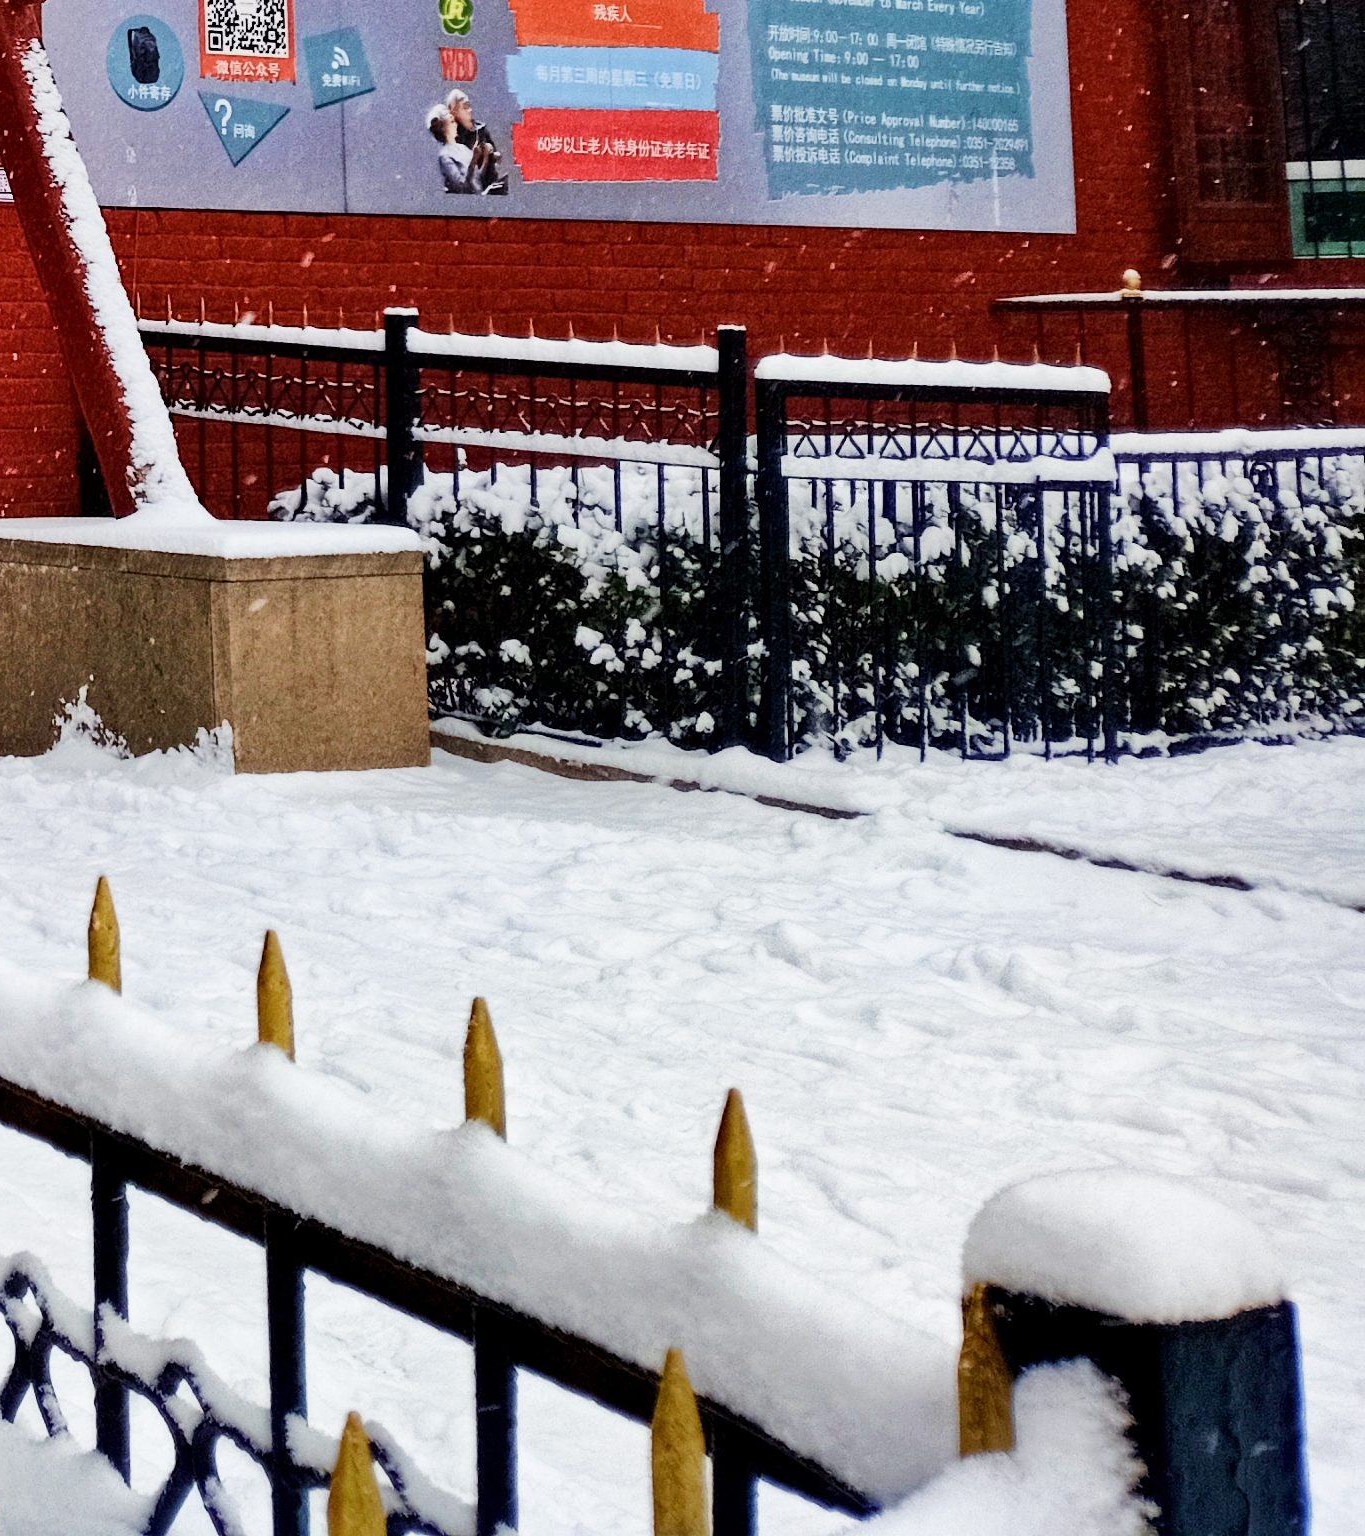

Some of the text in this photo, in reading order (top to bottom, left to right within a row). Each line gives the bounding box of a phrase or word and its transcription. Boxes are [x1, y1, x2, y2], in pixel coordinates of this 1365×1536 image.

[594, 3, 633, 23] 残疾人
[959, 0, 985, 17] Year)
[768, 46, 809, 64] Opening
[889, 53, 920, 69] 17:00
[215, 60, 280, 78] 微信公众号
[127, 84, 173, 101] 小件寄存
[791, 71, 820, 83] museum
[821, 71, 838, 84] will
[841, 73, 852, 85] be
[855, 74, 884, 87] closed
[887, 77, 898, 87] on
[900, 76, 927, 91] Monday
[930, 78, 952, 92] until
[955, 79, 986, 93] further
[770, 104, 839, 125] 票价批准文号
[842, 108, 877, 125] (Price
[881, 110, 924, 129] Approval
[233, 123, 256, 140] 问询
[771, 124, 840, 145] 票价咨询电话
[843, 127, 906, 149] (Consulting
[537, 135, 711, 161] 60岁以上老人持身份证或老年证
[772, 144, 841, 165] 票价投诉电话
[844, 147, 900, 167] (Complaint
